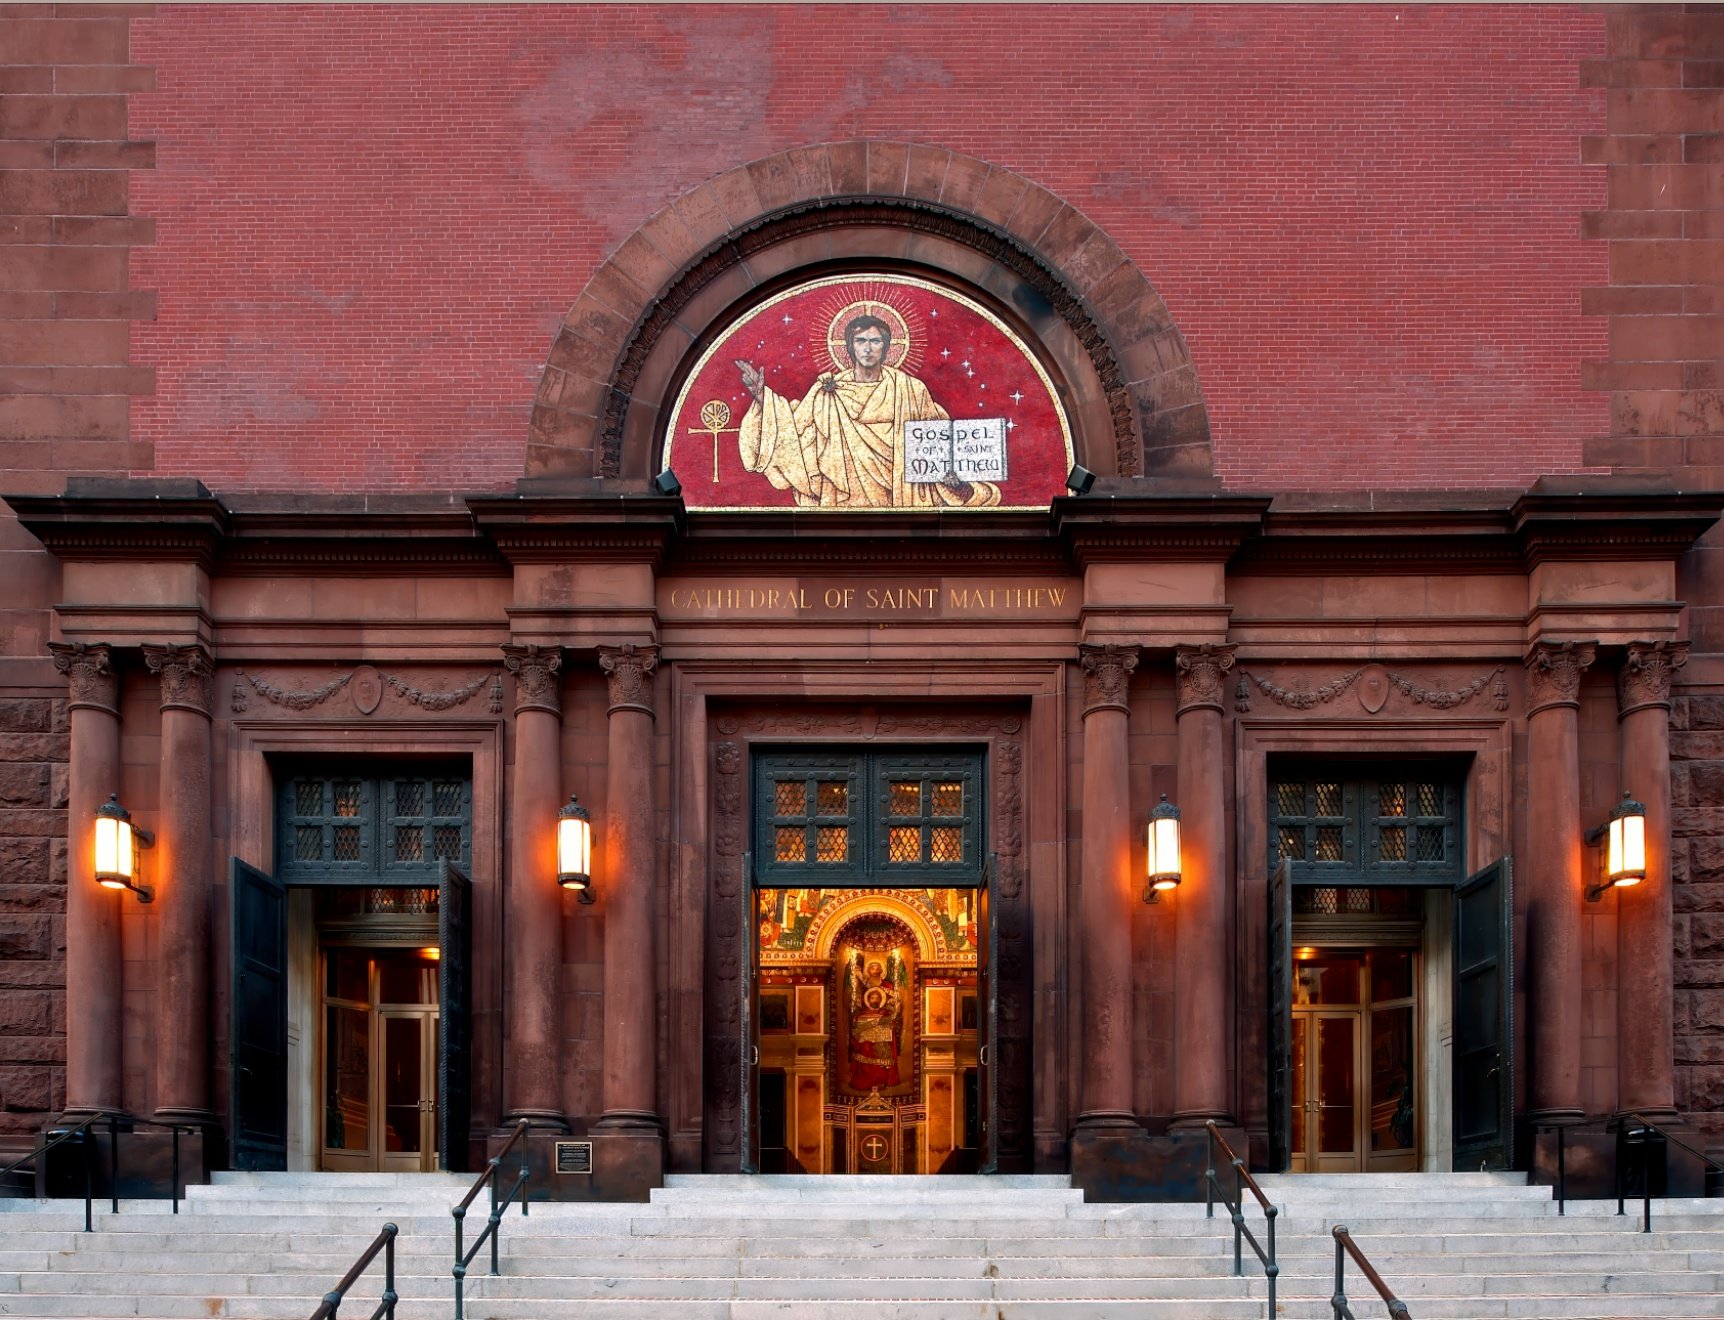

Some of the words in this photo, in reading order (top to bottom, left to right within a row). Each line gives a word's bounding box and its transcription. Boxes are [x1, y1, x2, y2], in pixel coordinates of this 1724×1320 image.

[671, 589, 812, 609] CATHEDRAL
[824, 588, 855, 609] OF
[866, 588, 939, 609] SAINT
[950, 588, 1067, 609] MATTHEW
